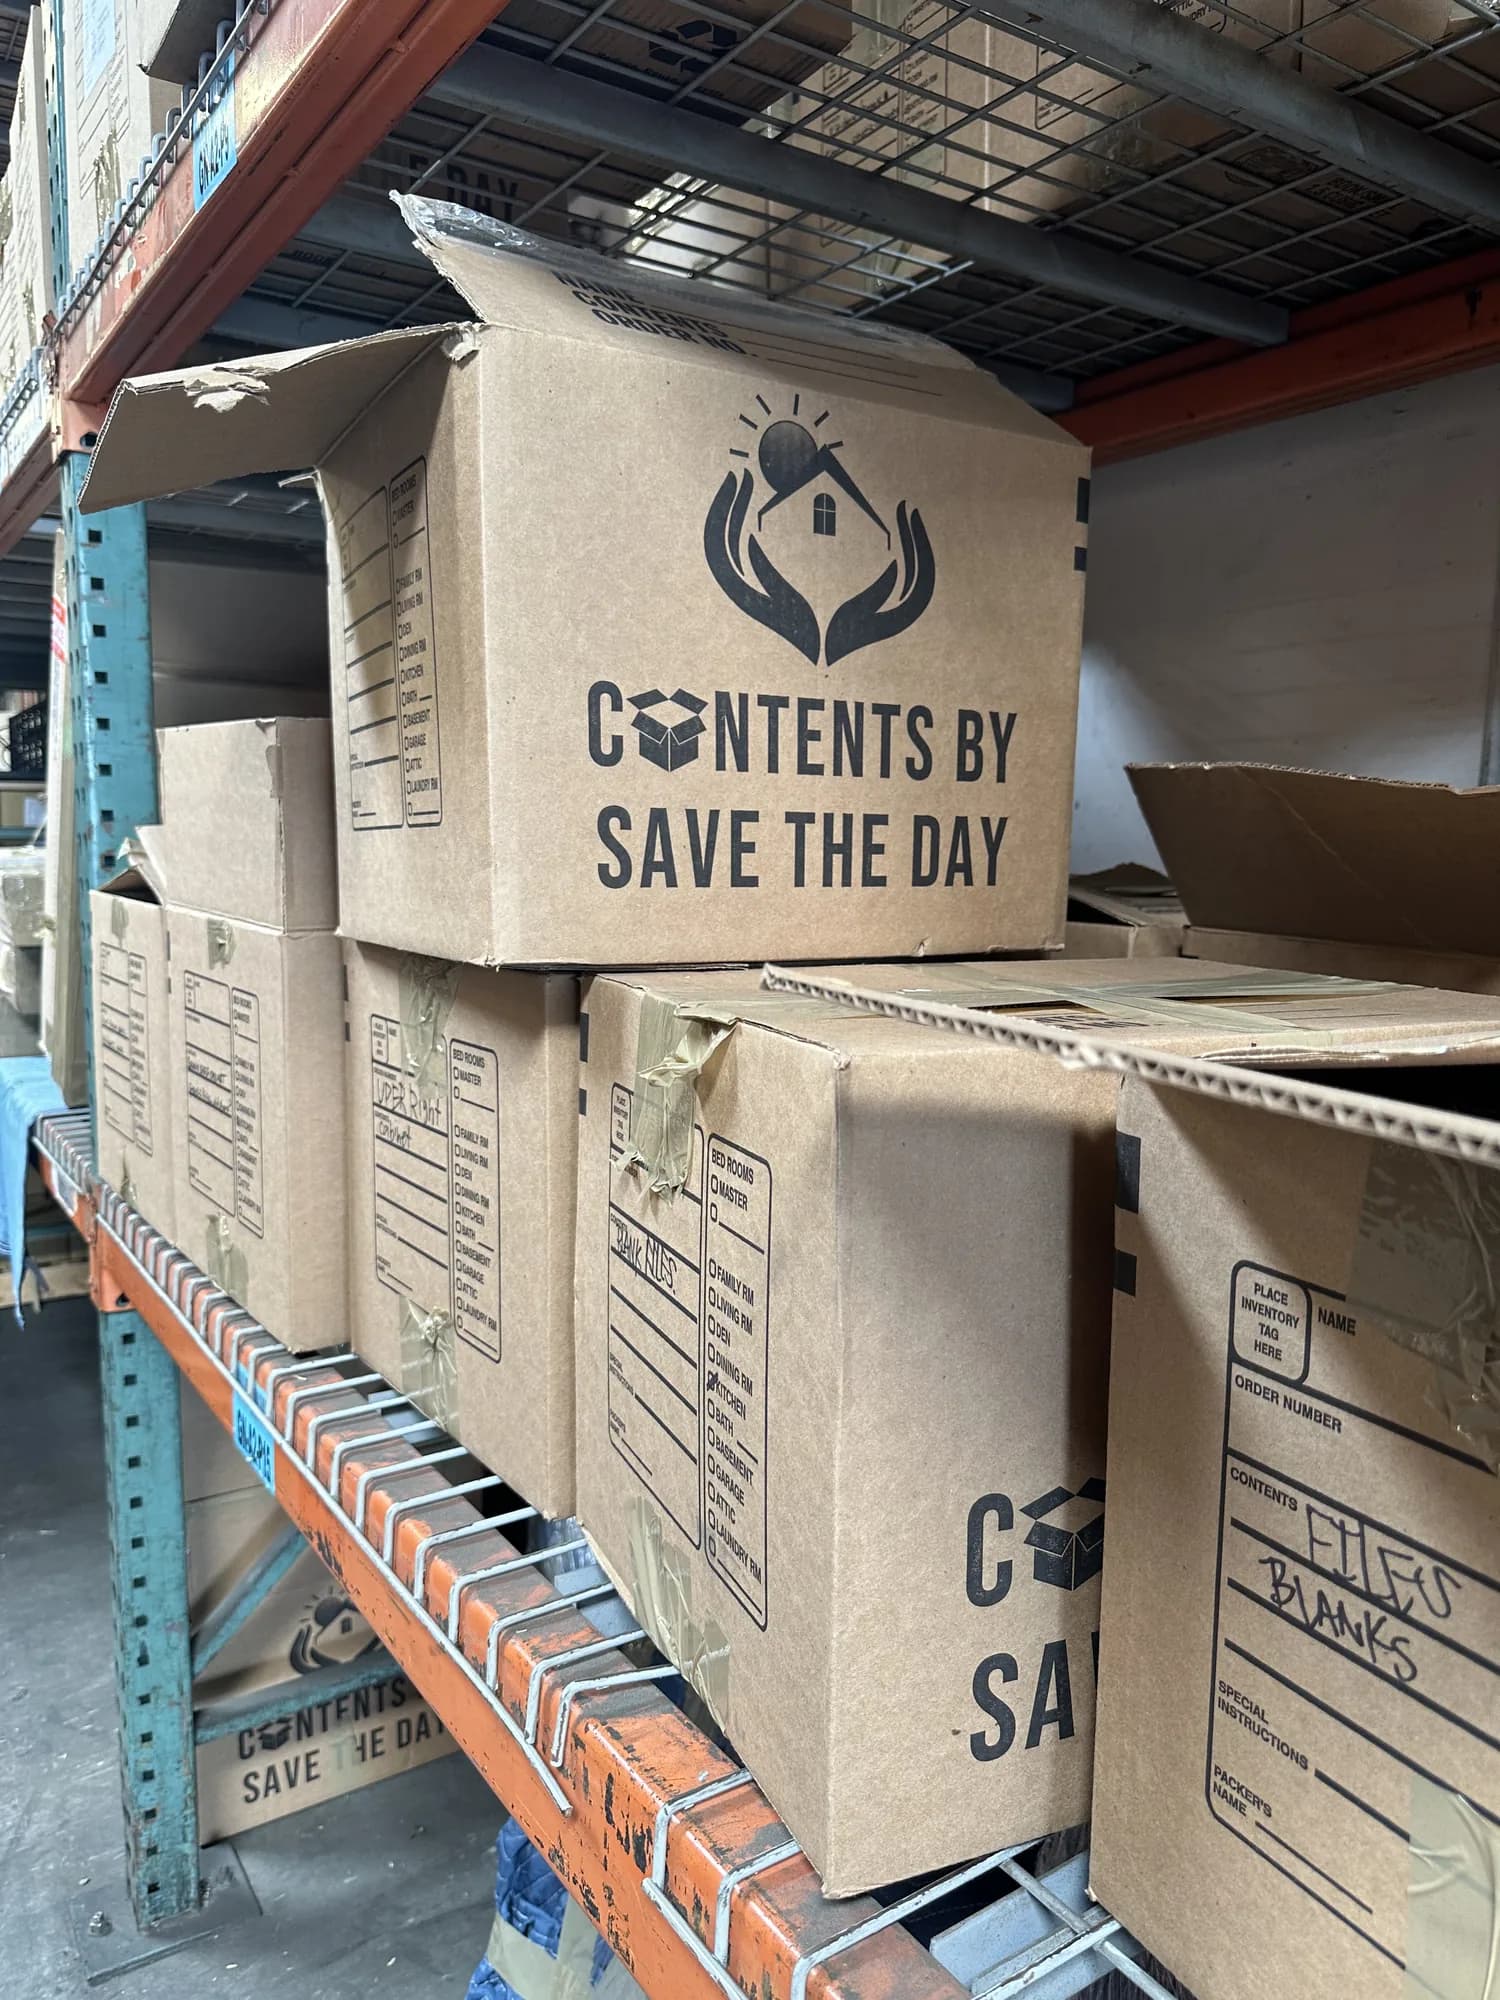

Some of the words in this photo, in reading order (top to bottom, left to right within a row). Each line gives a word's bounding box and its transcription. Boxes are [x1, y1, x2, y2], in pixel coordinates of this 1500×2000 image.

[551, 271, 645, 305] NAME
[572, 290, 729, 338] CONTENTS
[591, 308, 701, 345] ORDER
[402, 621, 412, 637] DEN
[405, 663, 424, 682] KITCHEN
[406, 691, 418, 704] BATH
[407, 708, 431, 727] BASEMENT
[409, 733, 426, 749] GARAGE
[956, 709, 1018, 784] BY
[409, 757, 423, 771] ATTIC
[412, 777, 430, 794] LAUNDRY
[431, 777, 439, 791] RM
[597, 805, 760, 889] SAVE
[784, 811, 889, 888] THE
[910, 814, 1009, 888] DAY
[452, 1048, 464, 1061] BED
[464, 1051, 486, 1069] ROOMS
[459, 1071, 482, 1087] MASTER
[460, 1127, 479, 1146] FAMILY
[479, 1135, 489, 1149] RM
[461, 1147, 479, 1165] LIVING
[479, 1156, 489, 1169] RM
[461, 1165, 473, 1181] DEN
[711, 1148, 725, 1168] BED
[727, 1157, 755, 1186] ROOMS
[461, 1185, 480, 1204] DINING
[480, 1196, 490, 1210] RM
[719, 1180, 748, 1212] MASTER
[461, 1204, 485, 1227] KITCHEN
[462, 1224, 476, 1241] BATH
[462, 1243, 492, 1267] BASEMENT
[462, 1263, 485, 1285] GARAGE
[716, 1265, 741, 1296] FAMILY
[742, 1285, 755, 1307] RM
[462, 1282, 479, 1300] ATTIC
[1254, 1282, 1289, 1306] PLACE
[463, 1300, 488, 1325] LAUNDRY
[488, 1319, 497, 1333] RM
[715, 1292, 741, 1323] LIVING
[741, 1315, 753, 1336] RM
[1241, 1296, 1300, 1329] INVENTORY
[1317, 1306, 1357, 1336] NAME
[716, 1322, 731, 1347] DEN
[1258, 1322, 1280, 1341] TAG
[1253, 1339, 1283, 1362] HERE
[715, 1351, 740, 1384] DINING
[740, 1375, 753, 1397] RM
[715, 1379, 747, 1420] KITCHEN
[1234, 1374, 1280, 1406] ORDER
[1283, 1394, 1343, 1433] NUMBER
[715, 1408, 734, 1437] BATH
[715, 1435, 754, 1486] BASEMENT
[715, 1463, 746, 1507] GARAGE
[1230, 1466, 1298, 1512] CONTENTS
[715, 1491, 736, 1525] ATTIC
[716, 1519, 748, 1567] LAUNDRY
[749, 1559, 762, 1585] RM
[1305, 1502, 1463, 1620] FILES
[1258, 1557, 1418, 1683] BLANKS
[970, 1632, 1100, 1762] SA
[1217, 1680, 1270, 1725] SPECIAL
[1217, 1696, 1310, 1771] INSTRUCTIONS
[243, 1749, 321, 1804] SAVE
[1213, 1763, 1274, 1818] PACKER'S
[1212, 1781, 1248, 1818] NAME
